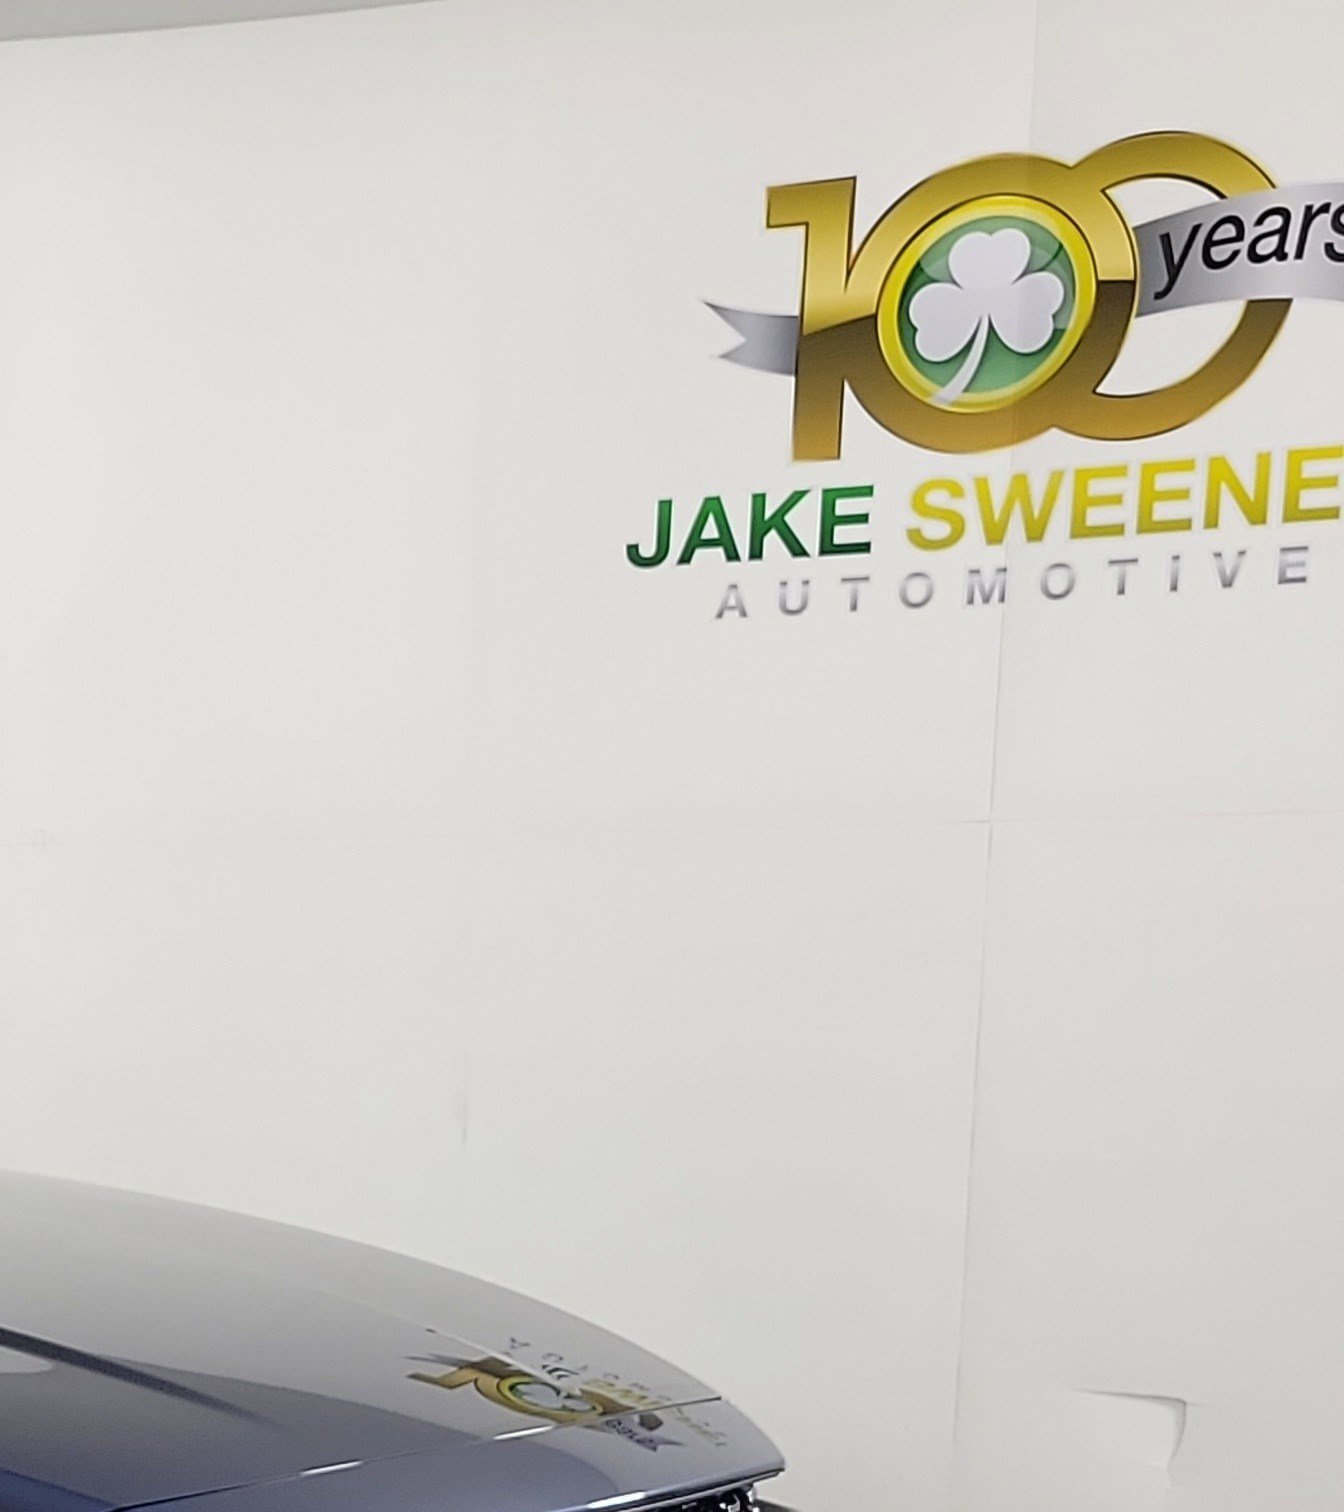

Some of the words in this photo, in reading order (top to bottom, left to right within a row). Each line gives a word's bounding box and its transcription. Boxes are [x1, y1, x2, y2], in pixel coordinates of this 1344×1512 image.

[765, 129, 1293, 462] 100
[625, 484, 875, 570] JAKE
[714, 546, 1311, 620] AUTOMOTIVE
